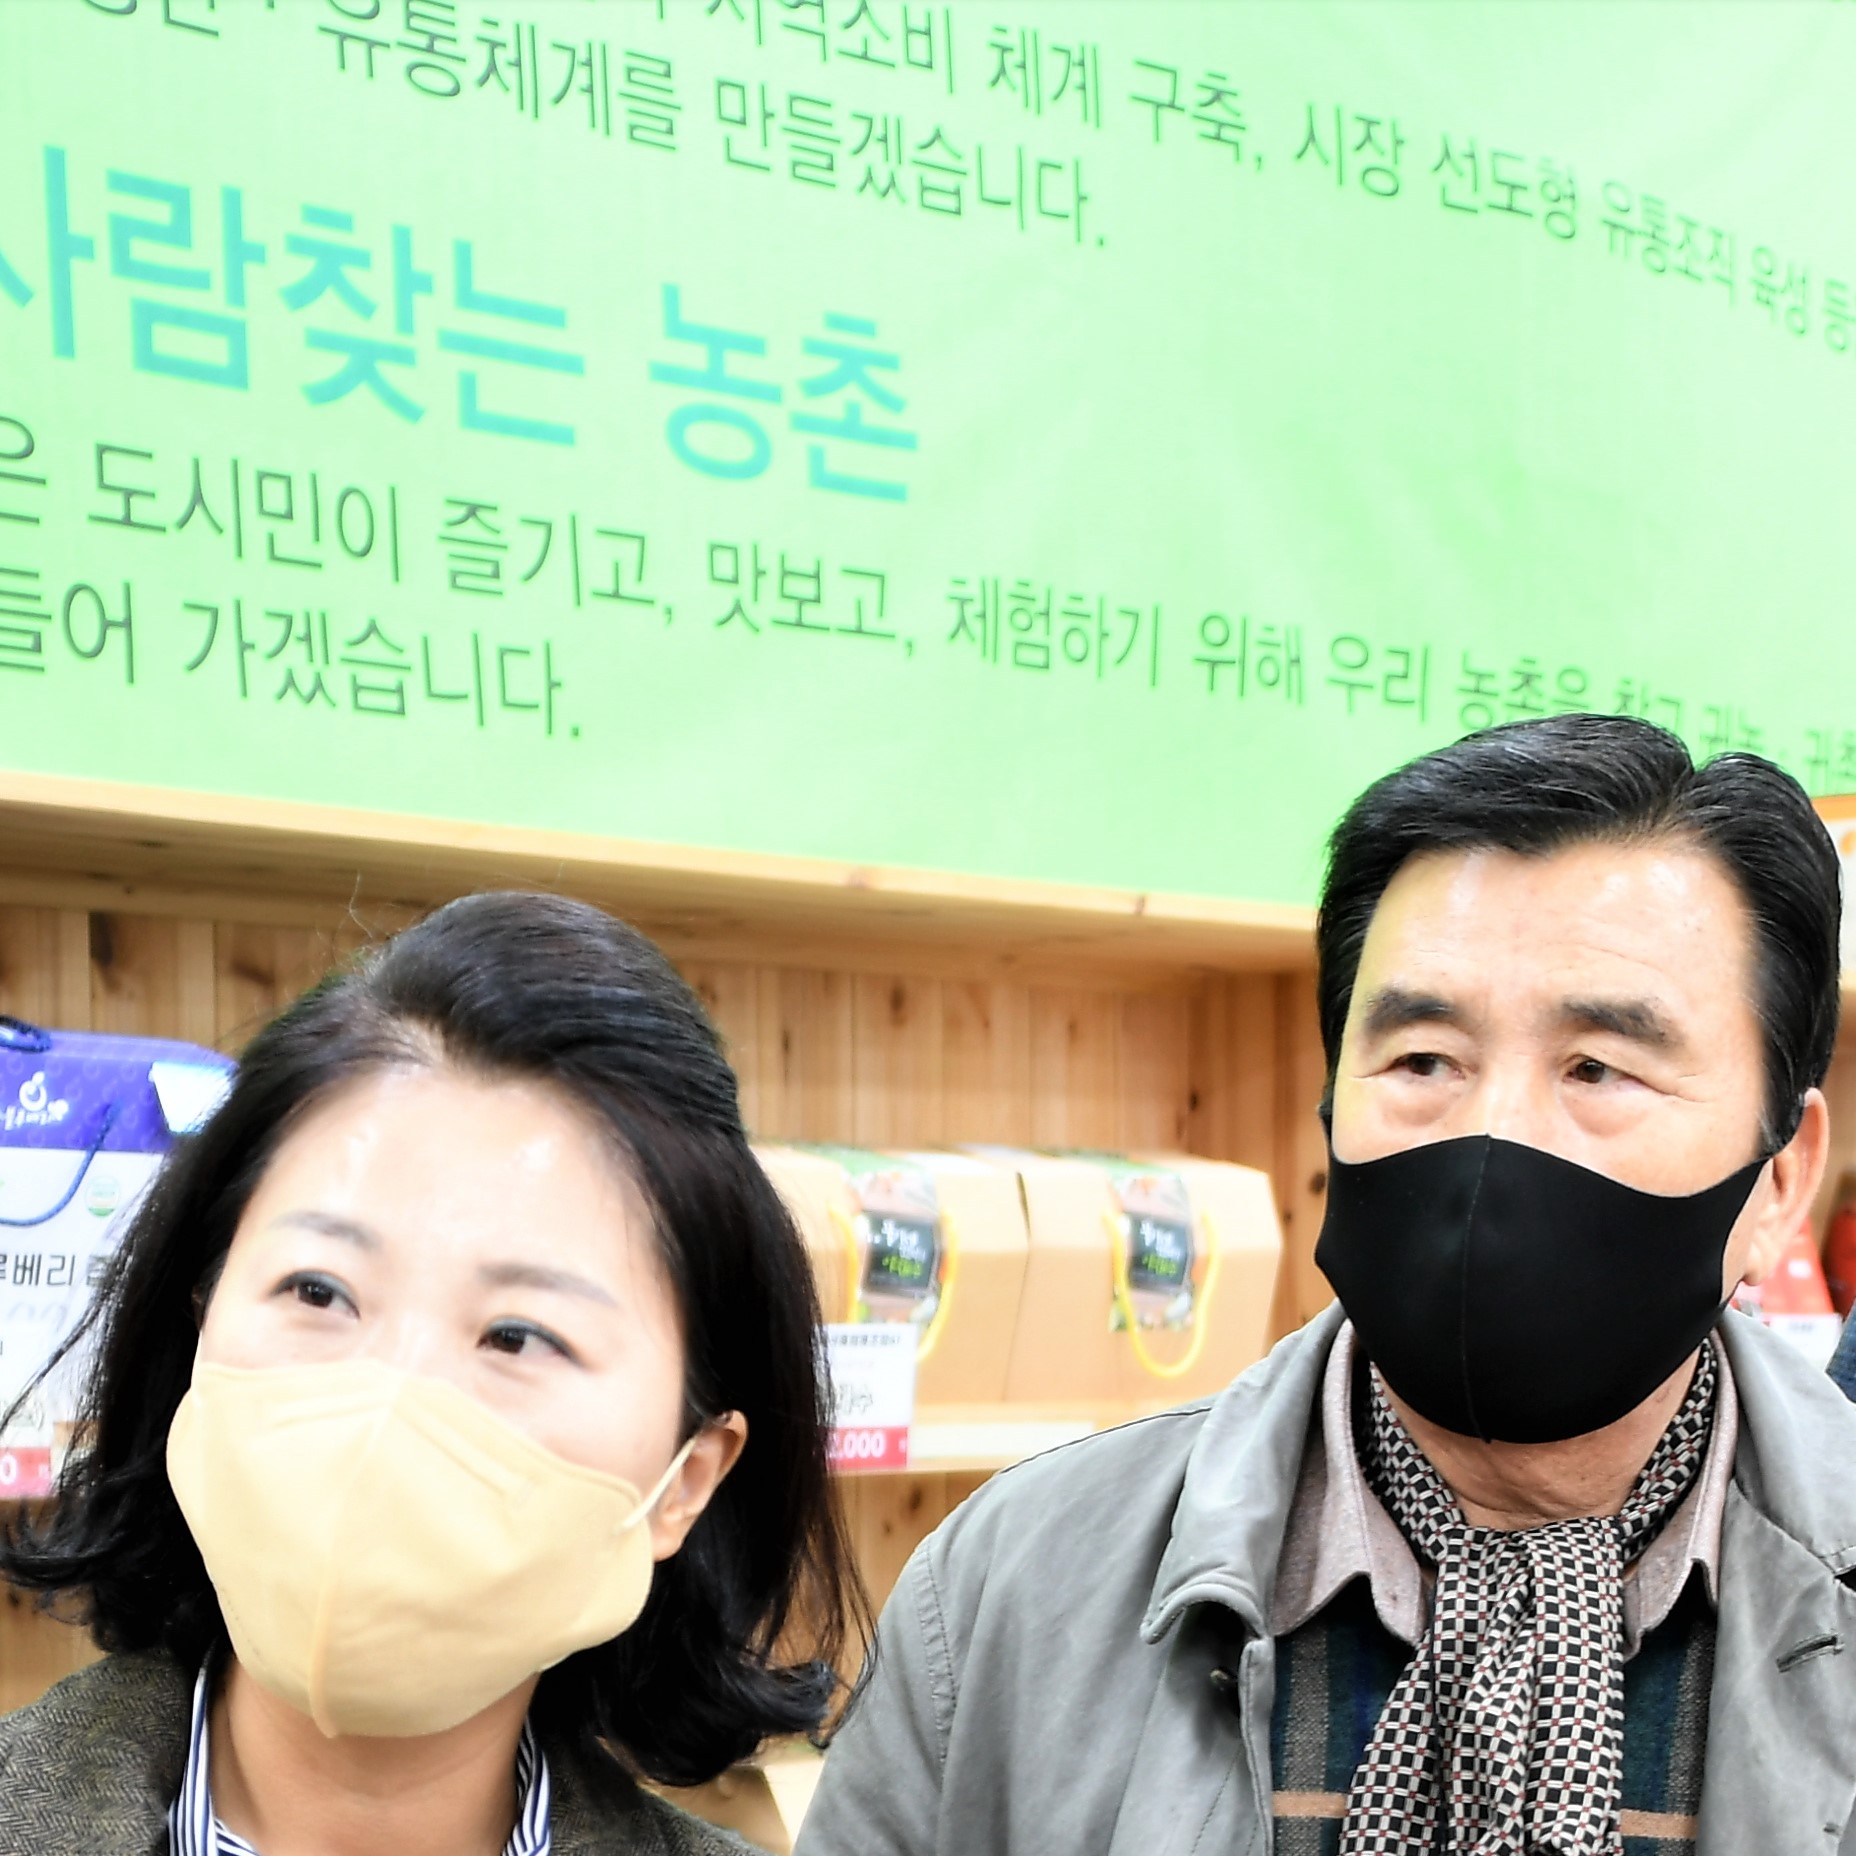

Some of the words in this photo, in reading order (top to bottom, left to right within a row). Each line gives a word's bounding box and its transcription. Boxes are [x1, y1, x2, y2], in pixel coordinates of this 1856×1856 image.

[316, 0, 684, 152] 유통체계를
[714, 77, 1107, 249] 만들겠습니다.
[989, 25, 1102, 128] 체계
[1130, 57, 1264, 171] 구축,
[1295, 103, 1405, 198] 시장
[1432, 133, 1578, 241] 선도형
[1600, 179, 1737, 308] 유통조직
[1750, 245, 1808, 337] 육성
[646, 281, 922, 503] 농촌
[86, 438, 406, 583] 도시민이
[437, 495, 676, 626] 즐기고,
[705, 537, 916, 659] 맛보고,
[947, 576, 1160, 688] 체험하기
[1193, 612, 1304, 706] 위해
[1326, 634, 1432, 723] 우리
[181, 598, 582, 738] 가겠습니다.
